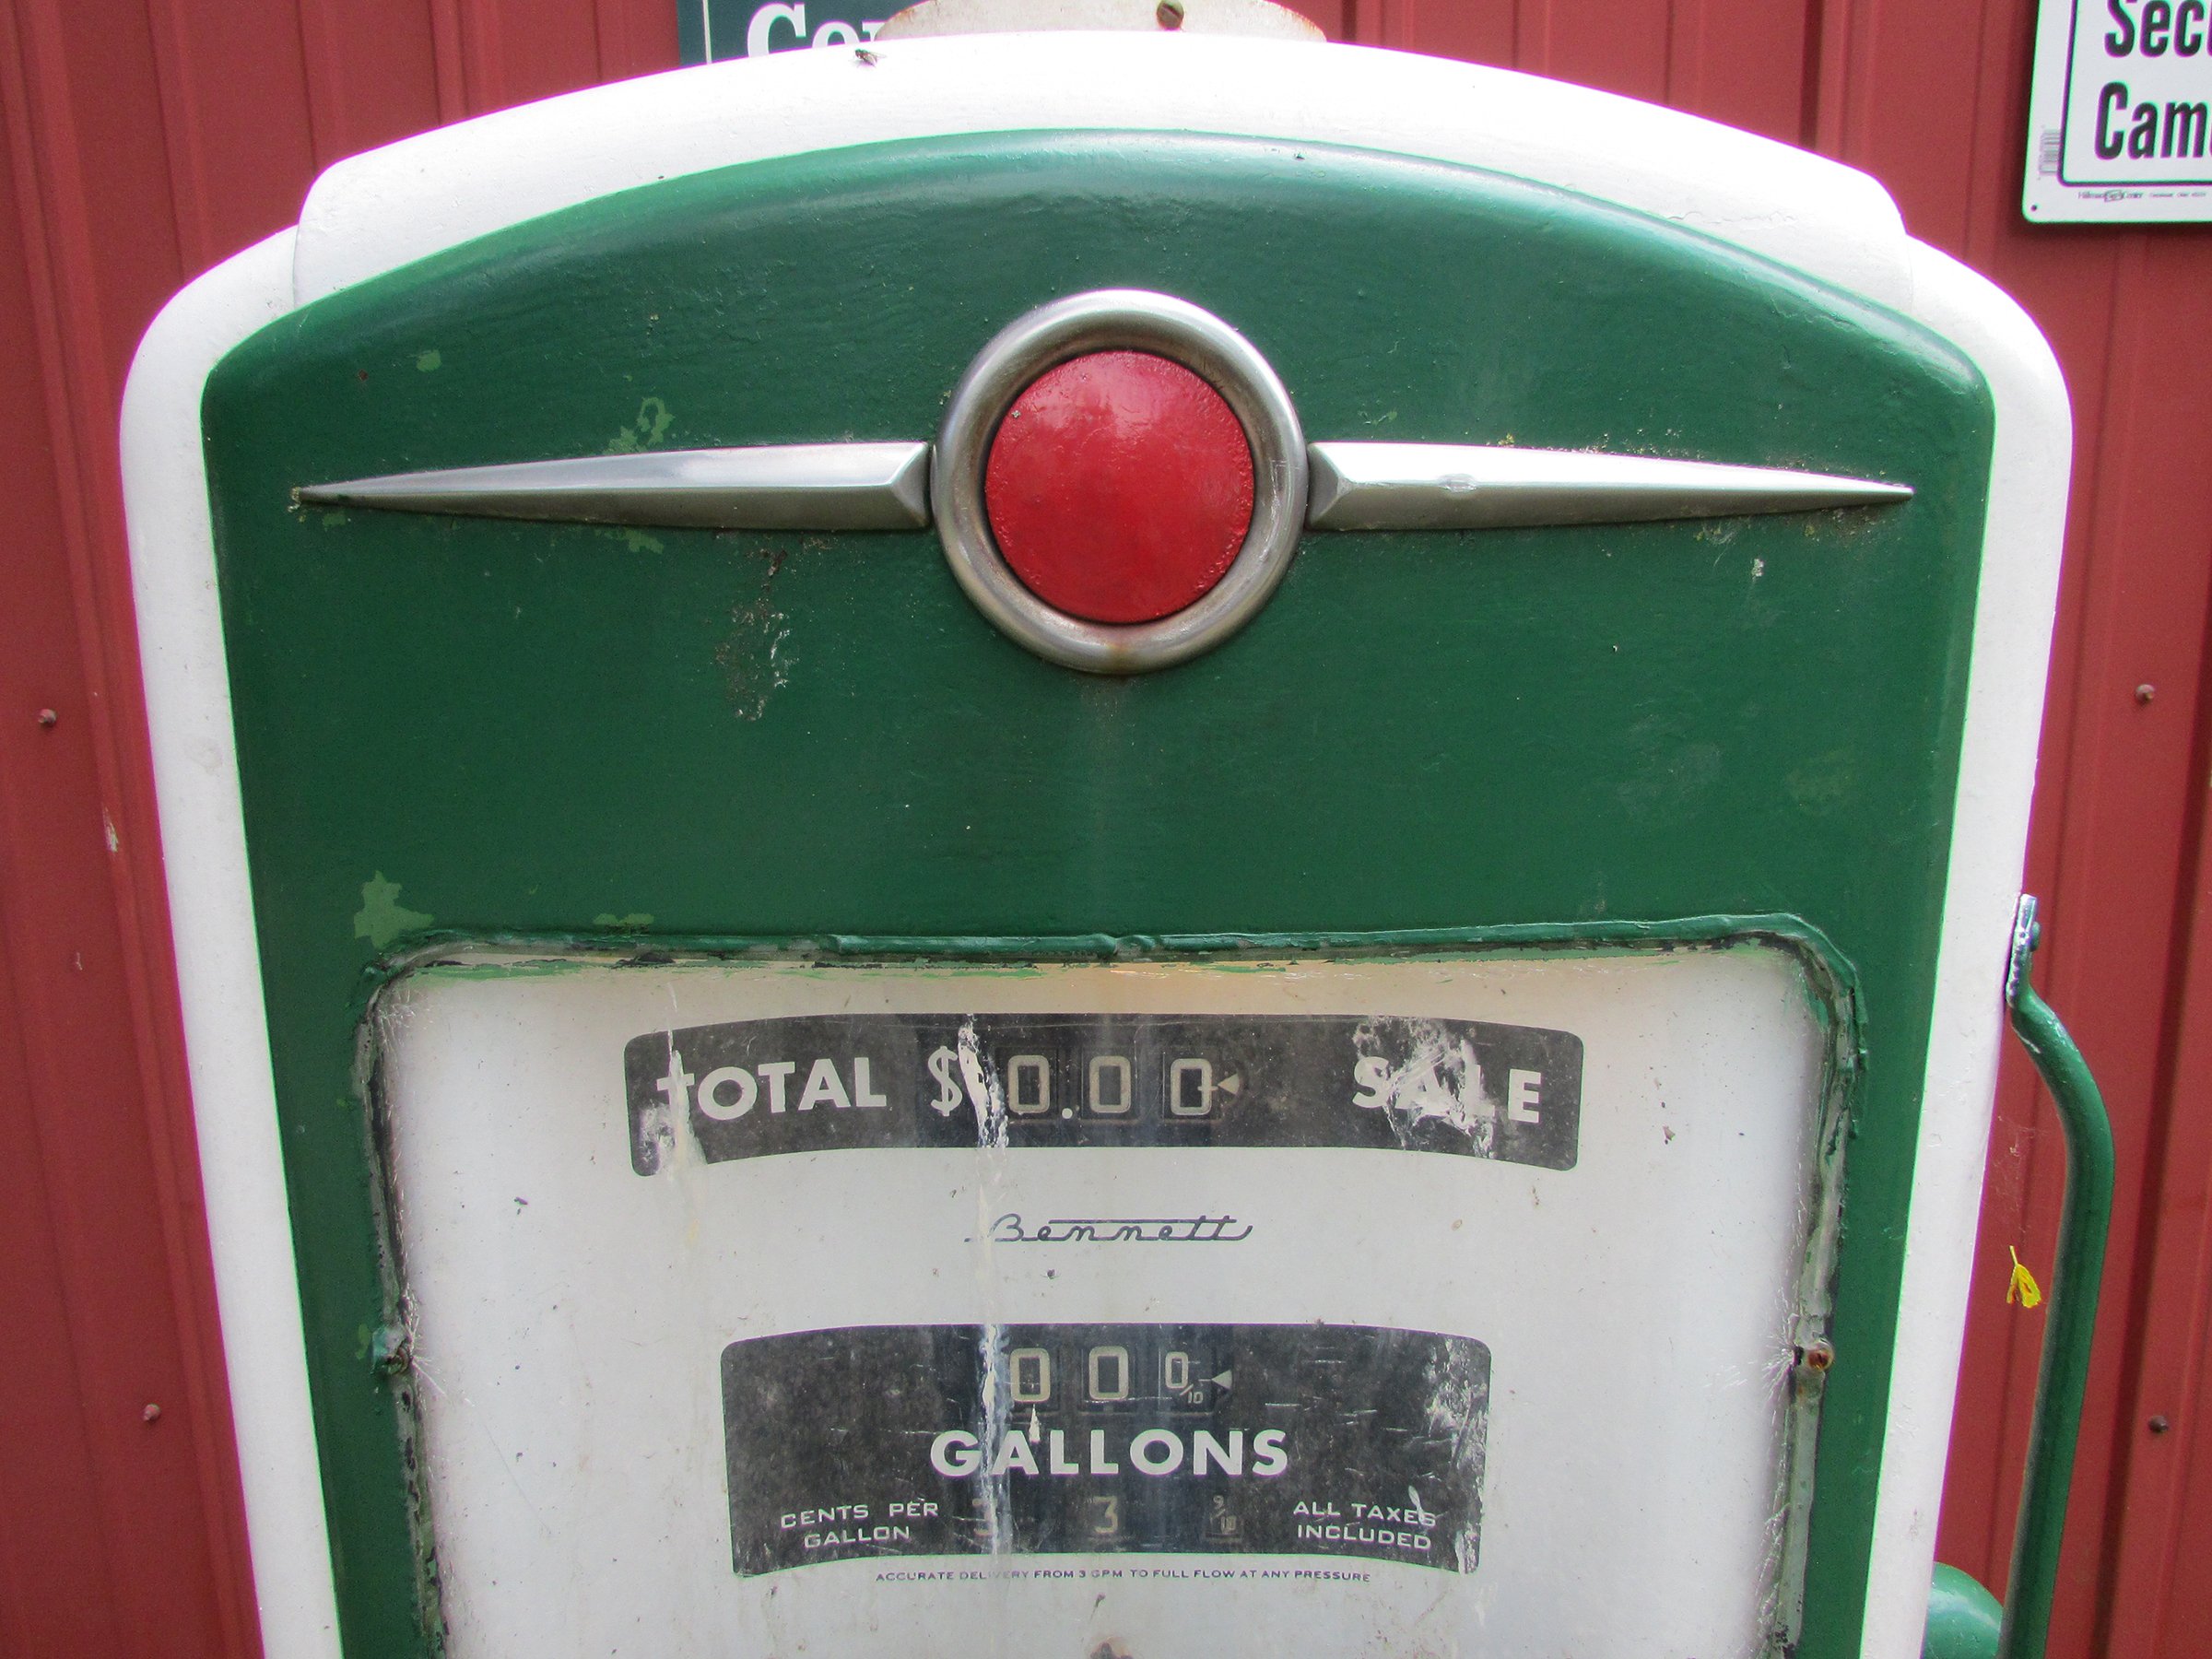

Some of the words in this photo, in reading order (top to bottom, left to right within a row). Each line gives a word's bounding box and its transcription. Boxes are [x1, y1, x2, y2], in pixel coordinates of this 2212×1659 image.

[2104, 0, 2212, 58] Sec
[2094, 81, 2212, 160] Cam
[657, 1056, 887, 1121] TOTAL
[964, 1213, 1253, 1241] Bennett
[930, 1429, 1289, 1477] GALLONS
[781, 1503, 869, 1528] CENTS
[888, 1501, 938, 1517] PER
[1293, 1500, 1341, 1516] ALL
[1351, 1502, 1436, 1527] TAXES
[804, 1525, 911, 1548] GALLON
[1297, 1524, 1431, 1550] INCLUDED
[876, 1571, 954, 1583] ACCURATE
[1034, 1570, 1075, 1580] FROM
[1130, 1570, 1149, 1580] TO
[1152, 1570, 1190, 1580] FULL
[1194, 1570, 1236, 1580] FLOW
[1240, 1570, 1258, 1580] AT
[1261, 1570, 1290, 1580] ANY
[1294, 1570, 1371, 1583] PRESSURE
